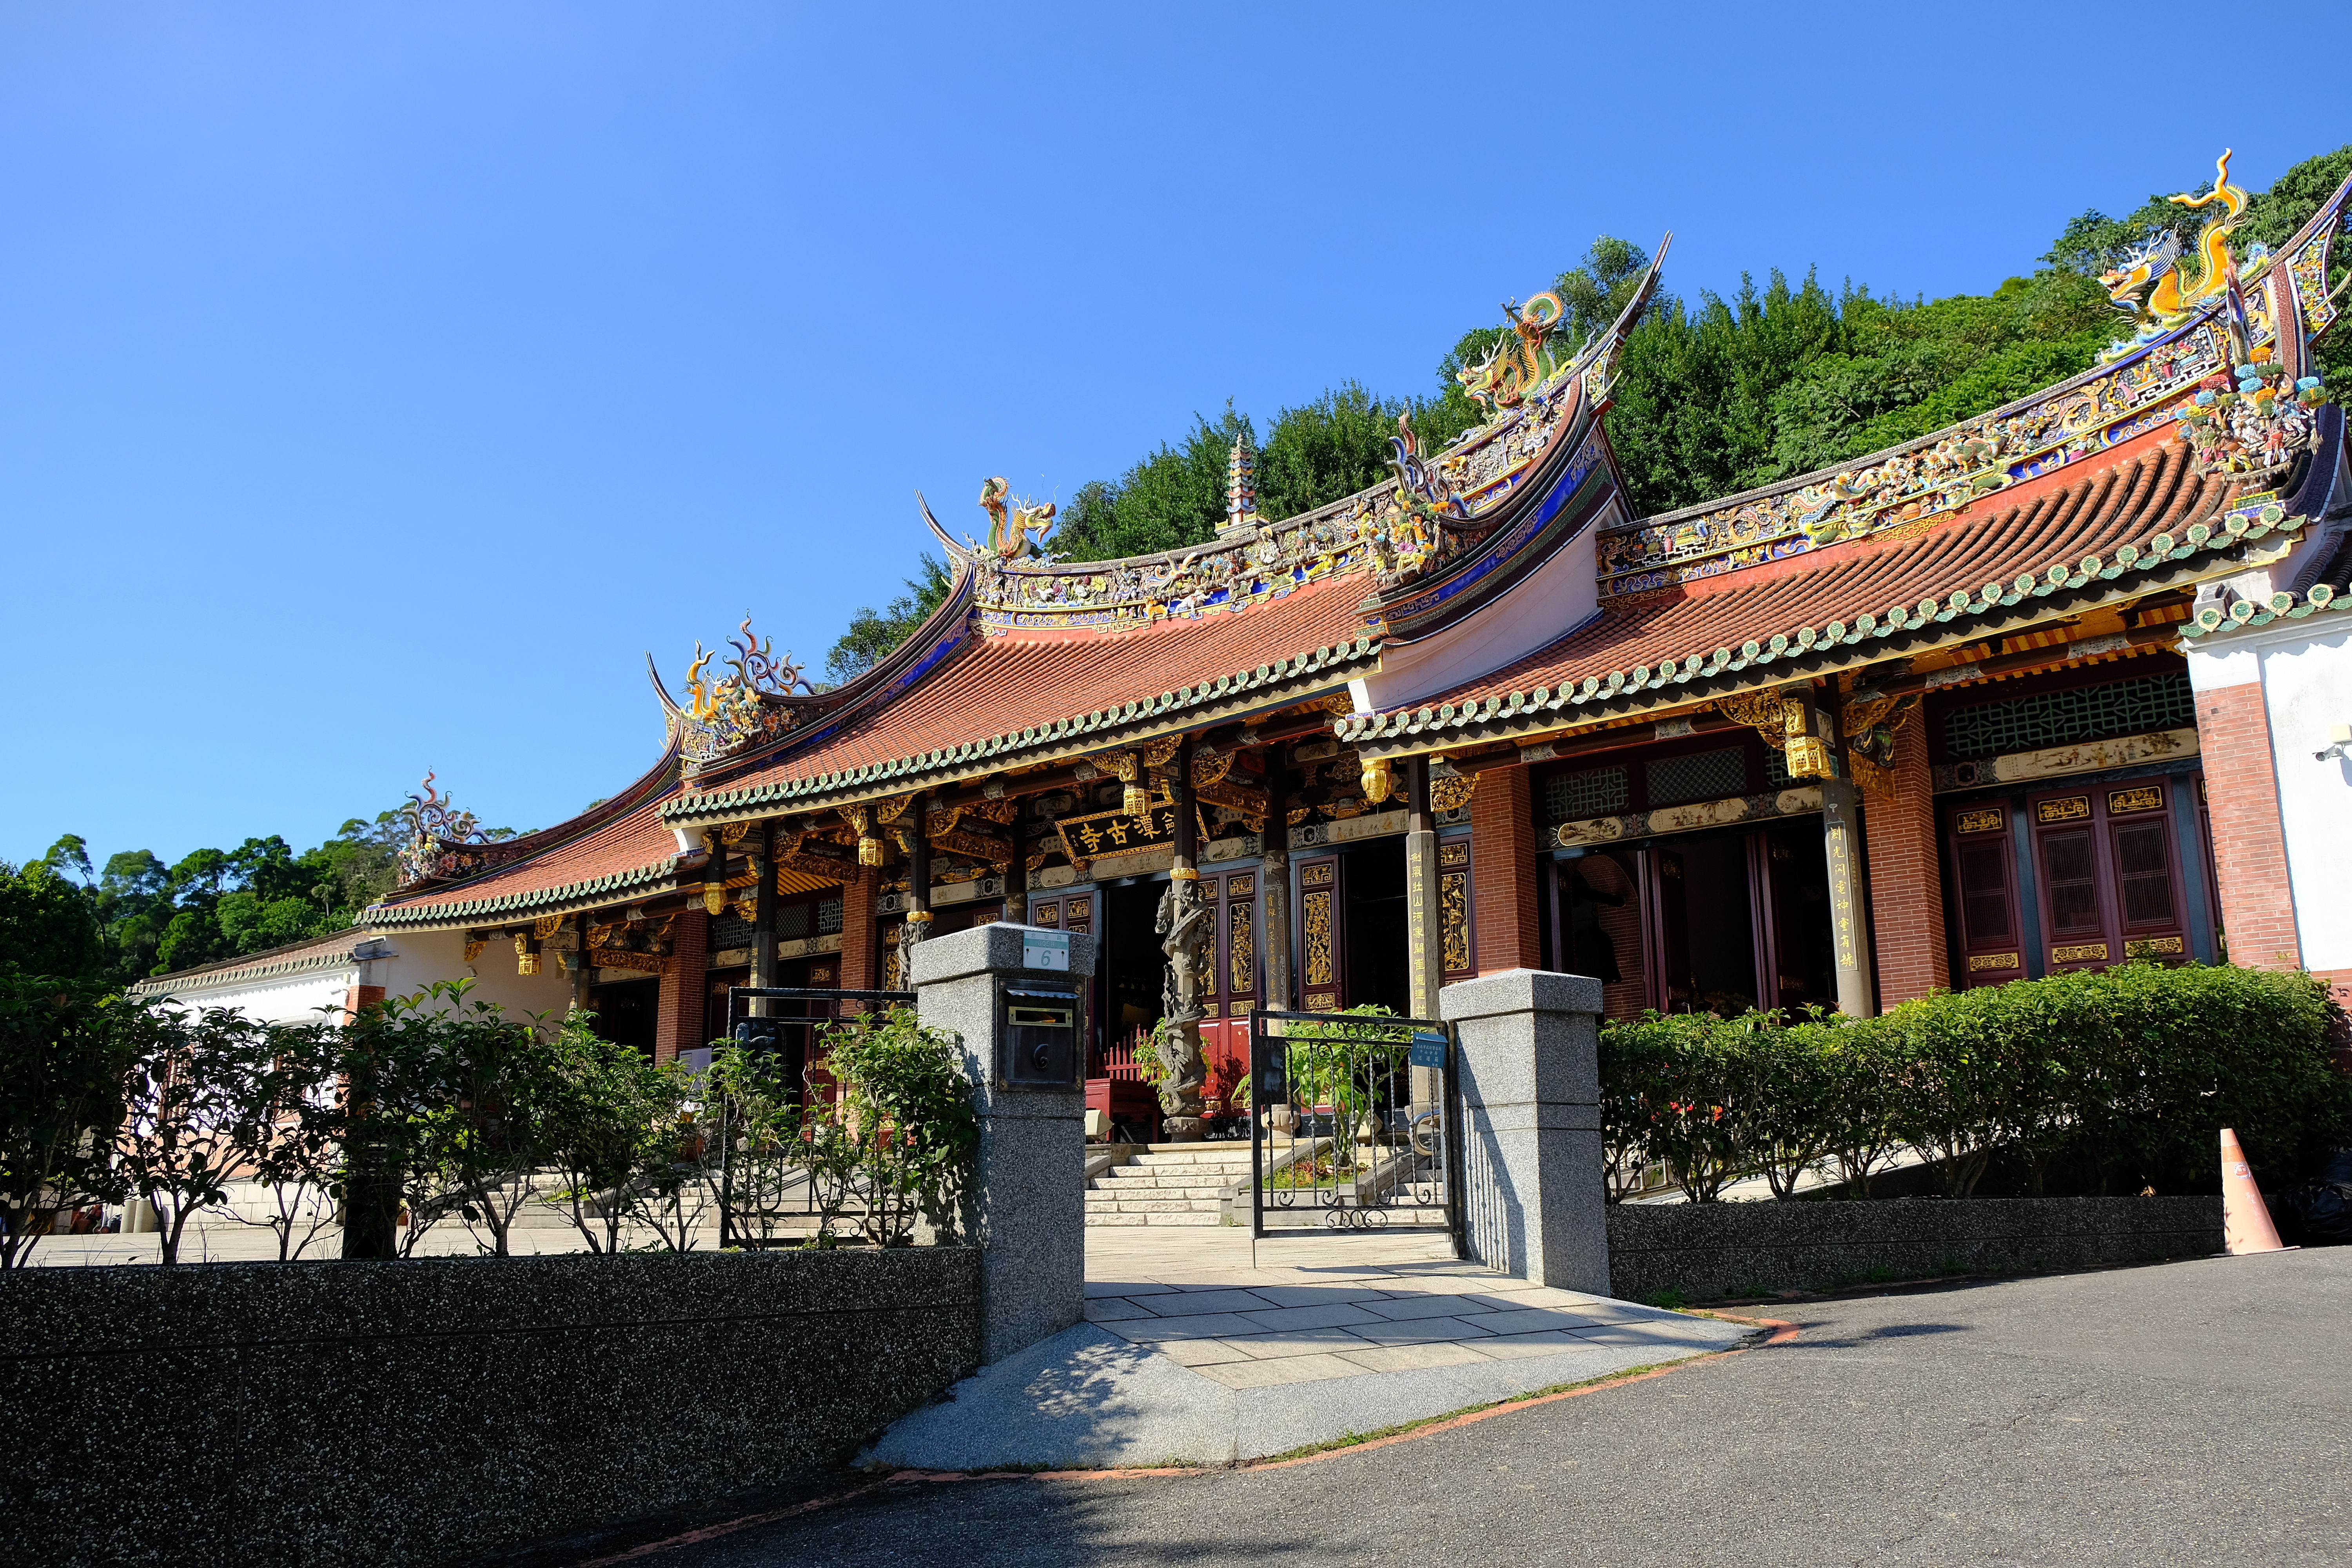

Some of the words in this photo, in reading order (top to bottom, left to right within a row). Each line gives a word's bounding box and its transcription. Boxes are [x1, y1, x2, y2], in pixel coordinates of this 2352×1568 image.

[1031, 933, 1062, 941] 北安路
[1041, 950, 1051, 966] 6
